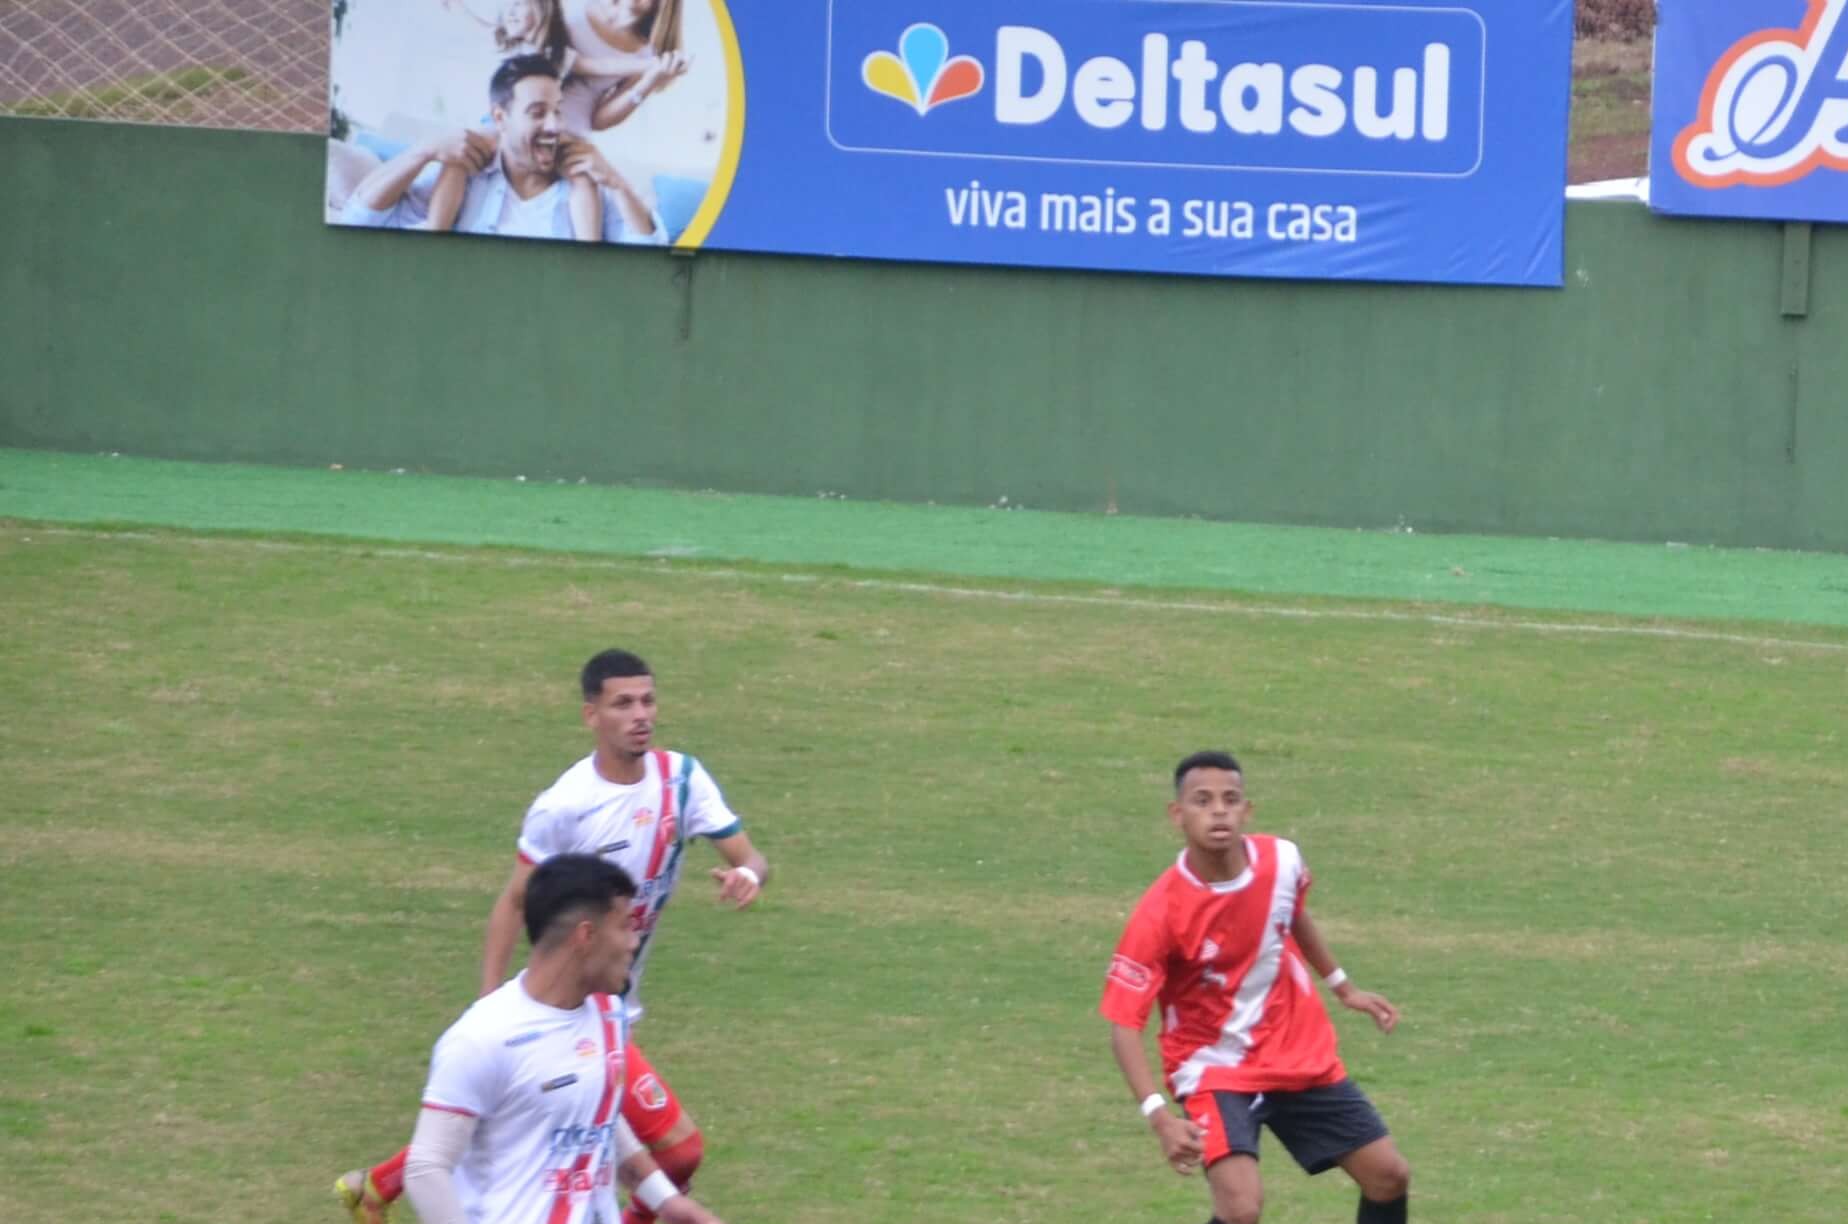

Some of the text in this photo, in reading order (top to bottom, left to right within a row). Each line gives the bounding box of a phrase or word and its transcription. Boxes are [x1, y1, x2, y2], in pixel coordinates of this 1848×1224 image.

[994, 25, 1450, 142] Deltasul
[945, 180, 1358, 242] viva mais a sua casa
